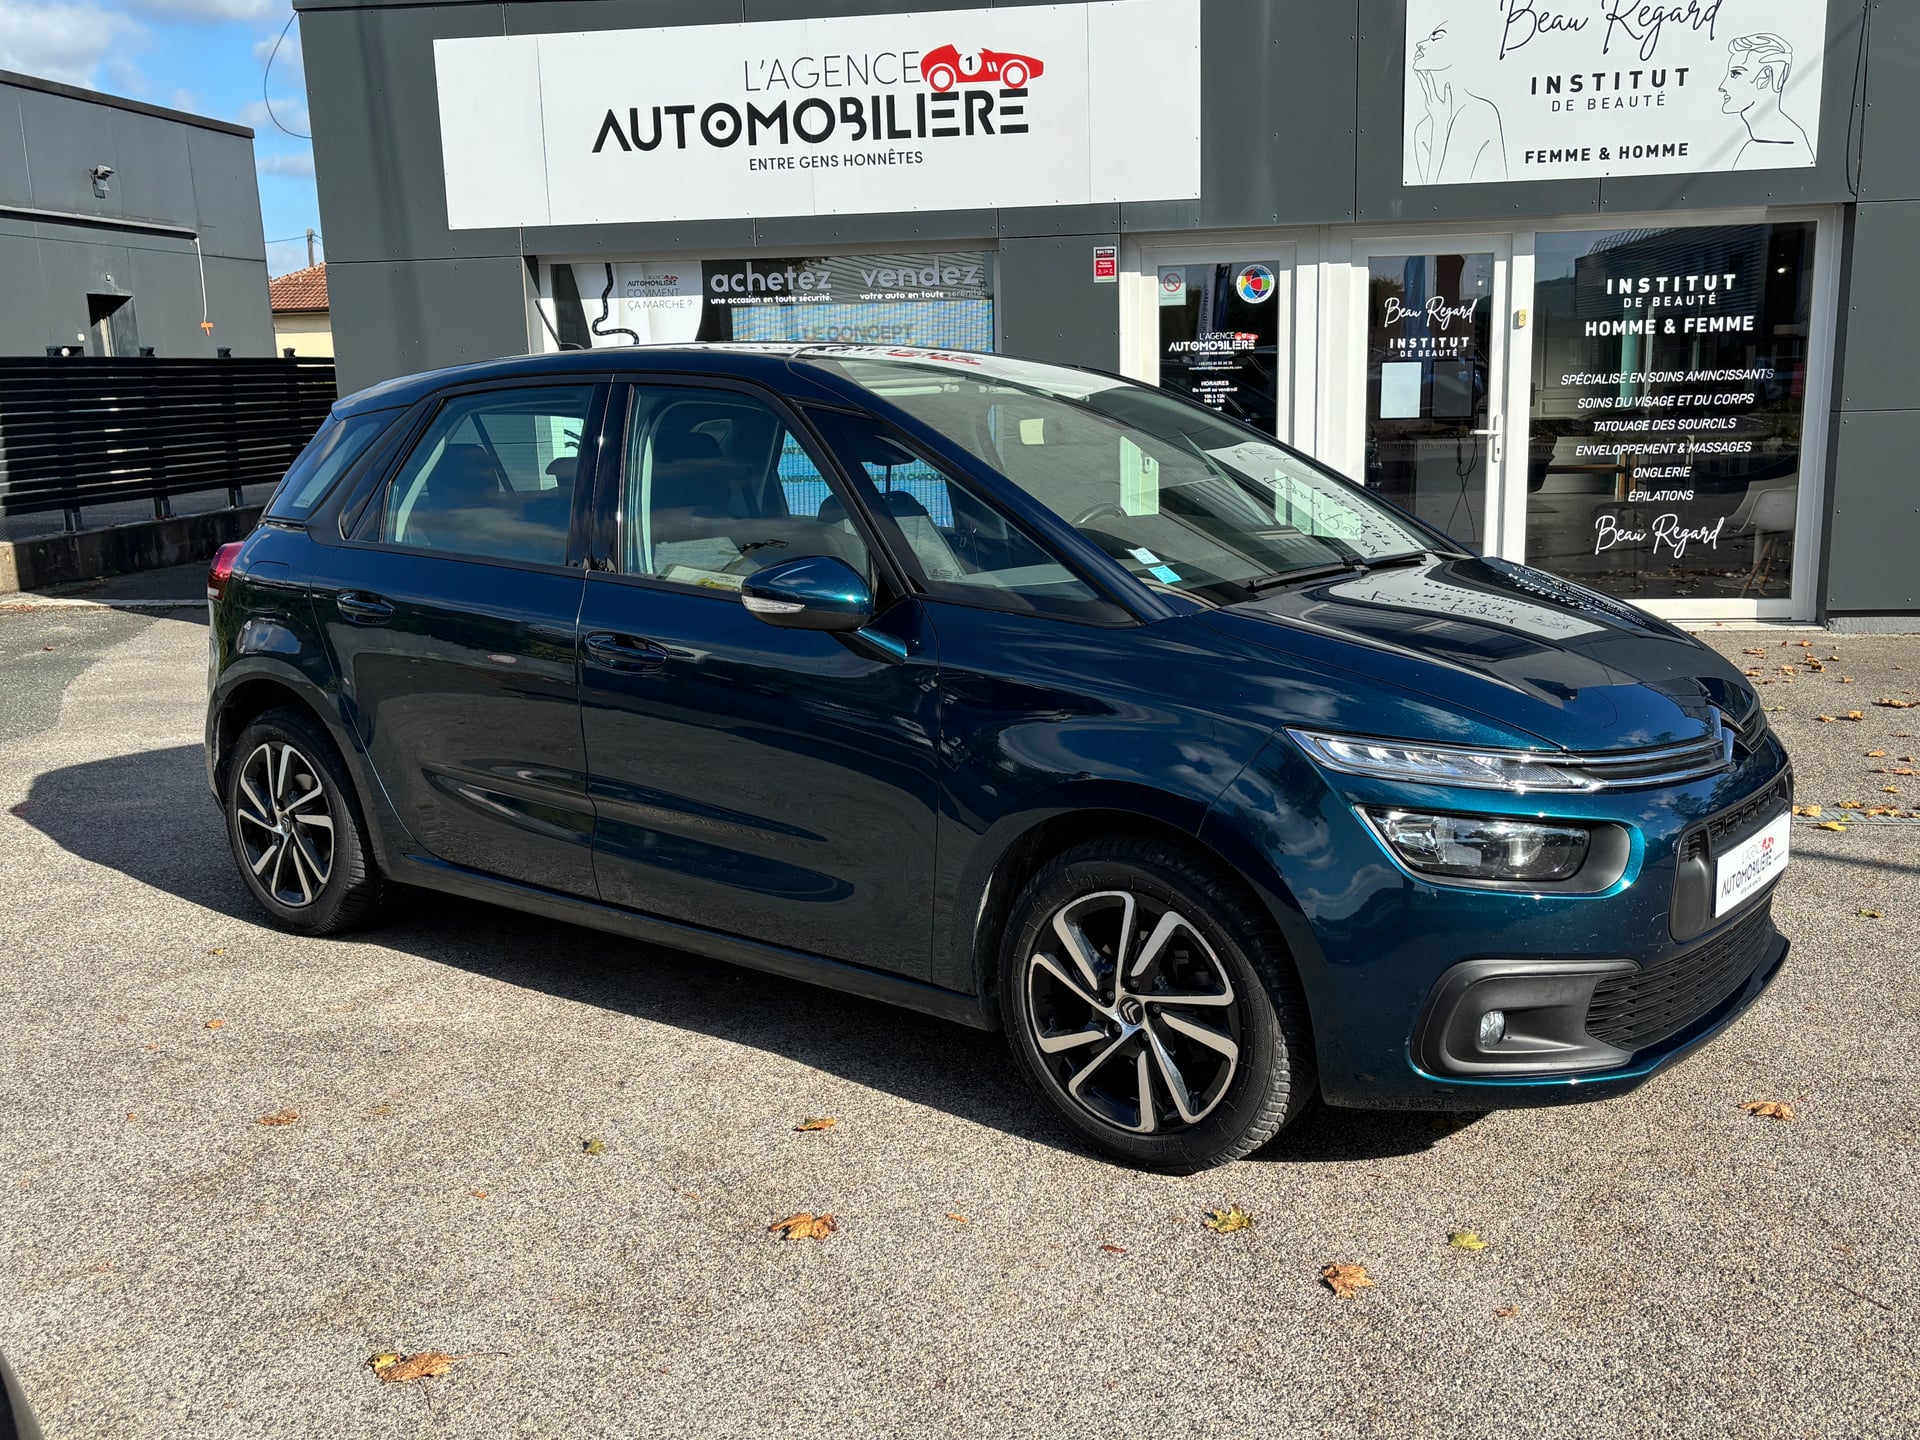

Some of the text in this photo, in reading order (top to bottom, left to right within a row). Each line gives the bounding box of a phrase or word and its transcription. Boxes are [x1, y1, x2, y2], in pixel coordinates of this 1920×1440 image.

[744, 51, 920, 91] L'AGENCE
[965, 56, 973, 71] 1
[1530, 67, 1690, 95] INSTITUT
[1551, 92, 1667, 113] DE BEAUTÉ
[749, 148, 923, 171] ENTRE GENS HONNÊTES
[1524, 142, 1689, 164] FEMME & HOMME
[710, 261, 832, 293] achetez
[860, 255, 980, 288] vendez
[1606, 273, 1736, 295] INSTITUT
[626, 288, 680, 298] COMMENT
[711, 297, 726, 305] une
[727, 294, 761, 304] occasion
[775, 294, 797, 303] toute
[799, 292, 833, 303] sécurité.
[860, 291, 883, 300] votre
[885, 291, 906, 300] auto
[908, 291, 919, 299] en
[921, 290, 944, 299] toute
[1623, 292, 1717, 308] DE BEAUTÉ
[627, 299, 693, 311] ÇA MARCHE ?
[1384, 295, 1478, 331] Beau Regard
[1585, 315, 1754, 337] HOMME & FEMME
[1199, 331, 1235, 341] L'AGENCE
[1389, 336, 1470, 349] INSTITUT
[1400, 348, 1458, 358] DE BEAUTÉ
[1560, 368, 1775, 385] SPÉCIALISÉ EN SOINS AMINCISSANTS
[1577, 393, 1755, 409] SOINS DU VISAGE ET DU CORPS
[1593, 417, 1737, 432] TATOUAGE DES SOURCILS
[1575, 441, 1752, 456] ENVELOPPEMENT & MASSAGES
[1632, 465, 1692, 479] ONGLERIE
[1627, 489, 1694, 502] ÉPILATIONS
[1594, 513, 1725, 559] Beau Regard
